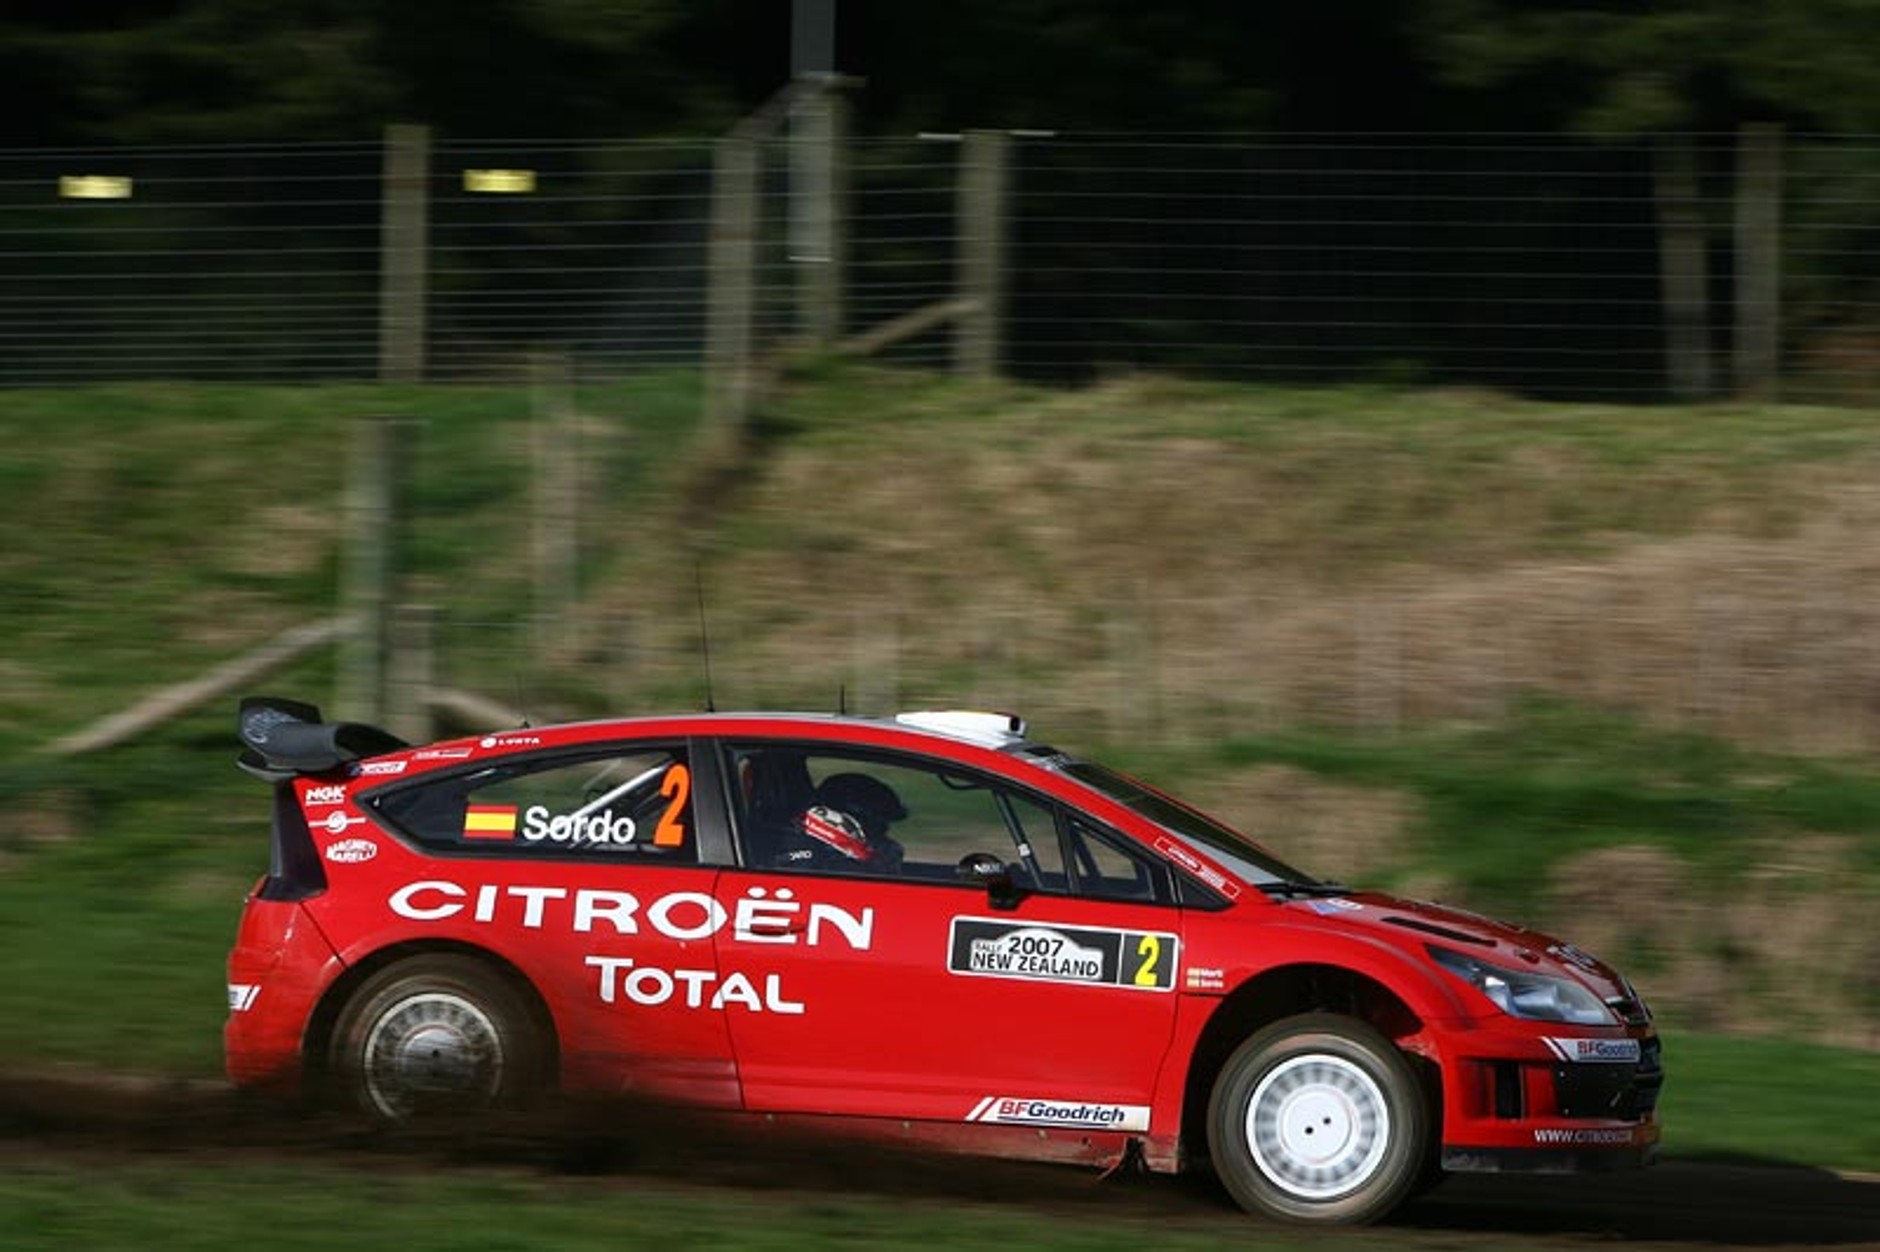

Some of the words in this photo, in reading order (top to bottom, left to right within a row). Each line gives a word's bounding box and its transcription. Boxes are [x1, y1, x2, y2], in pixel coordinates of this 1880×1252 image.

[306, 785, 346, 801] NGK
[653, 763, 690, 847] 2
[522, 805, 637, 844] Sordo
[388, 880, 874, 950] CITROËN
[1008, 936, 1064, 957] 2007
[1134, 935, 1160, 986] 2
[973, 952, 1012, 970] NEW
[1018, 956, 1098, 977] ZEALAND
[999, 1101, 1125, 1122] BFGoodrich
